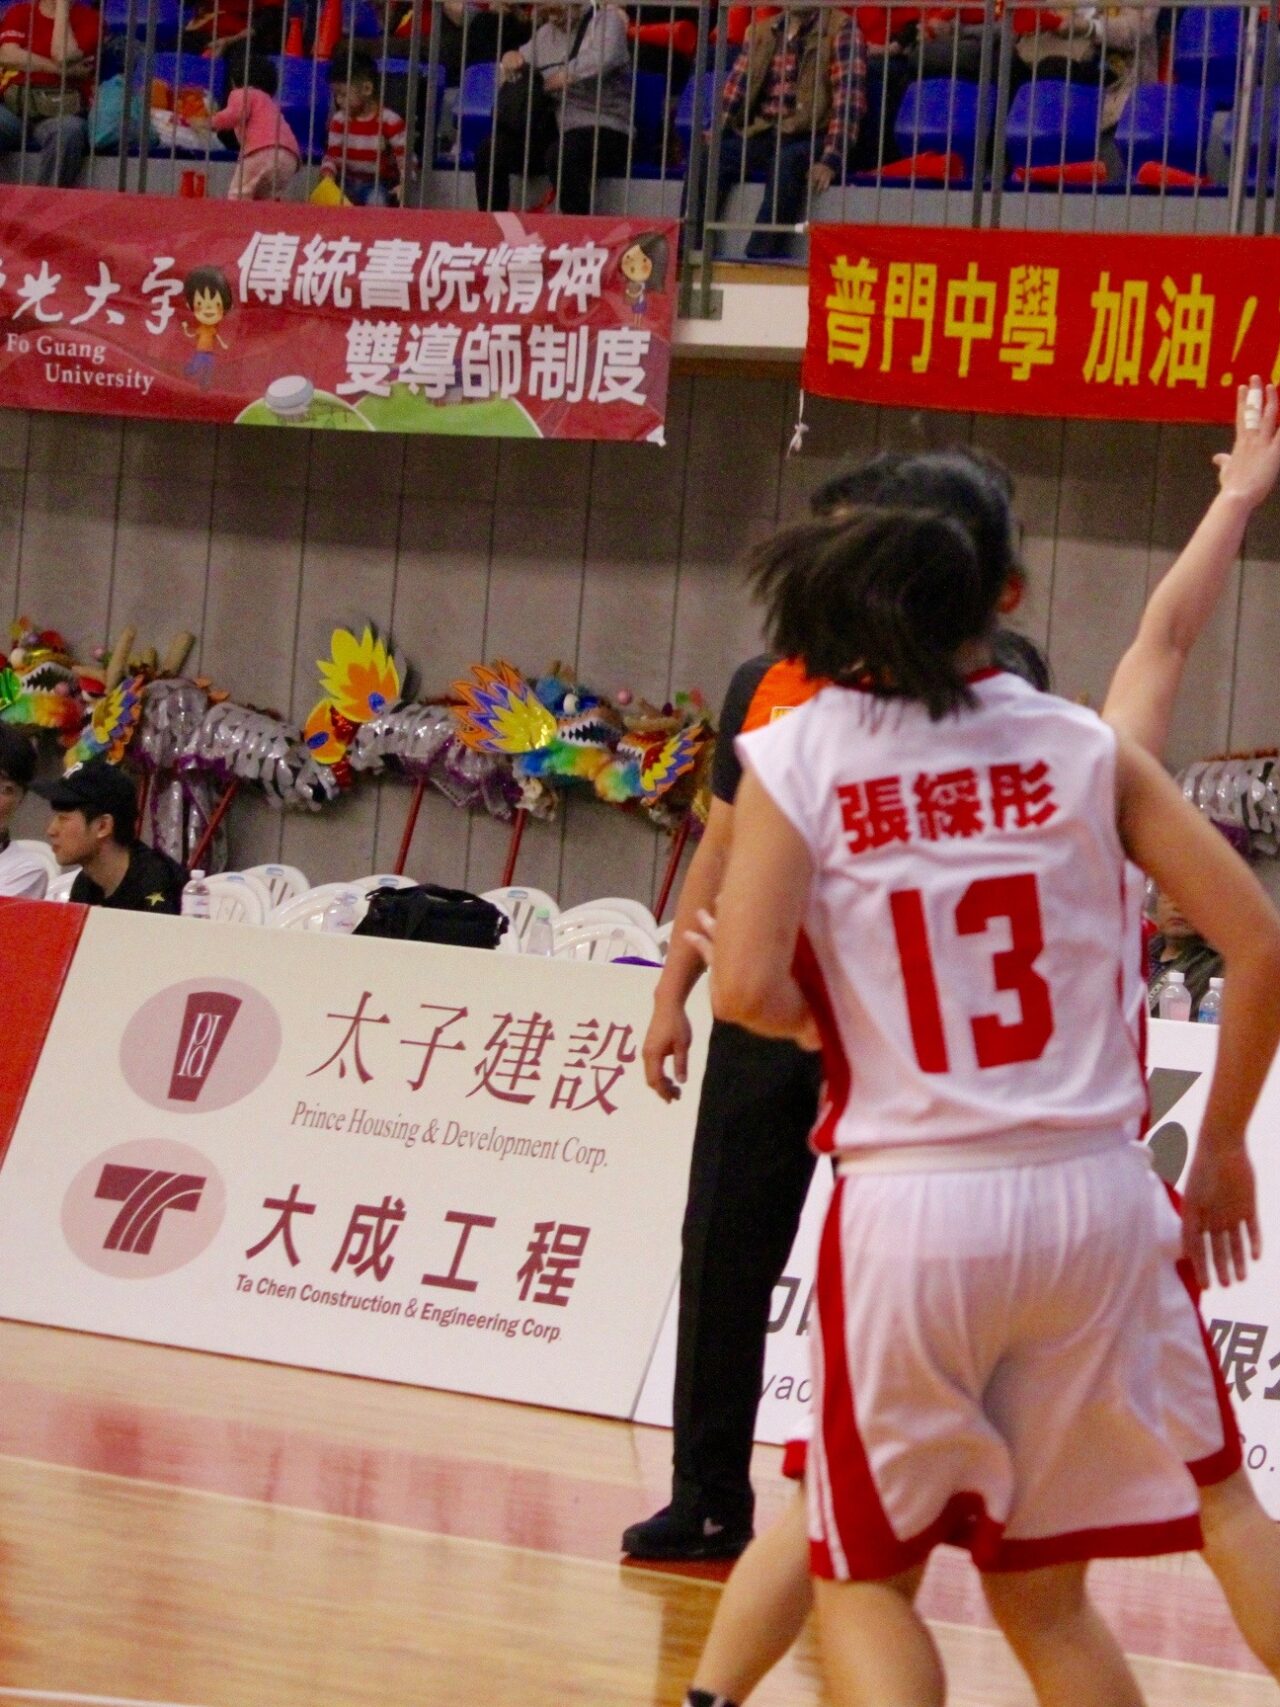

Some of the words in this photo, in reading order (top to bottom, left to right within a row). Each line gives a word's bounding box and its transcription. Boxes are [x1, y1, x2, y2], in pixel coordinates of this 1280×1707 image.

[238, 231, 609, 315] 傳統書院精神
[6, 332, 30, 354] Fo
[36, 335, 107, 364] Guang
[827, 255, 1060, 381] 普門中學
[45, 363, 154, 395] University
[336, 318, 651, 407] 雙導師制度
[889, 872, 1055, 1075] 13
[306, 990, 638, 1116] 太子建設
[291, 1100, 346, 1132] Prince
[348, 1107, 420, 1148] Housing
[421, 1119, 440, 1144] &
[441, 1119, 560, 1161] Development
[561, 1136, 609, 1174] Corp.
[245, 1183, 591, 1307] 大成工程
[235, 1273, 254, 1293] Ta
[256, 1276, 297, 1300] Chen
[299, 1283, 402, 1316] Construction
[404, 1297, 418, 1319] &
[420, 1302, 521, 1338] Engineering
